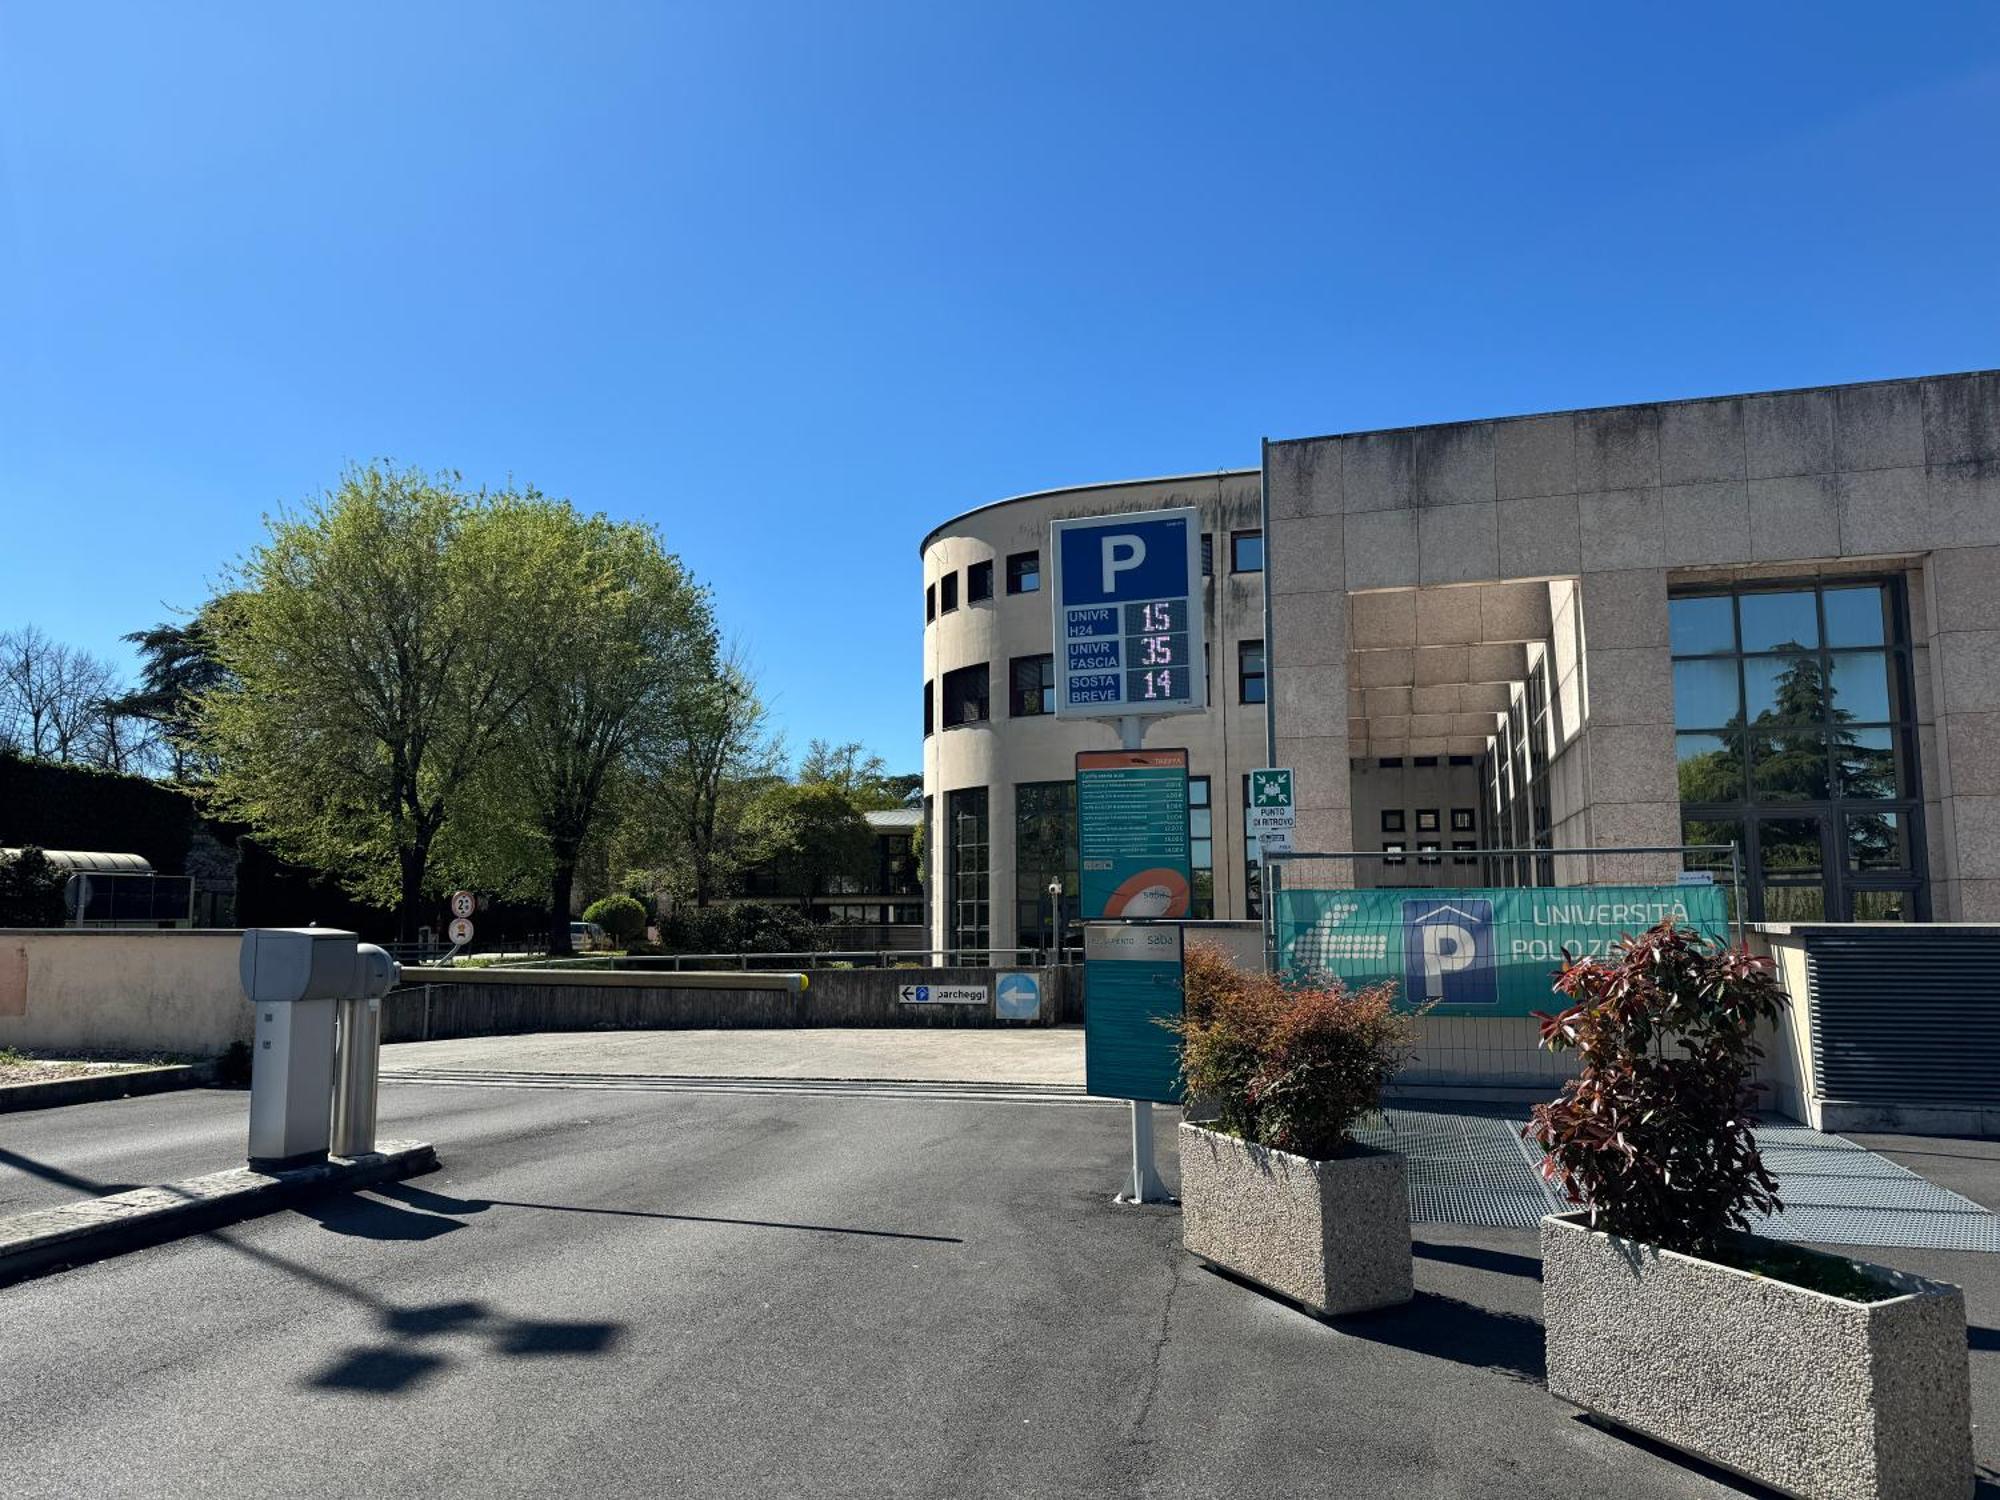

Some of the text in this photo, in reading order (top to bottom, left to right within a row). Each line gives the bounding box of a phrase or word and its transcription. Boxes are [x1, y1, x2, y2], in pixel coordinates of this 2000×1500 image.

[1101, 534, 1147, 594] P
[1069, 610, 1109, 622] UNIVR
[1142, 603, 1170, 631] 15
[1070, 625, 1093, 636] H24
[1070, 643, 1110, 655] UNIVR
[1141, 636, 1171, 665] 35
[1071, 657, 1118, 669] FASCIA
[1071, 676, 1115, 688] SOSTA
[1144, 670, 1171, 698] 14
[1071, 690, 1116, 702] BREVE
[1260, 807, 1285, 816] PUNTO
[1262, 818, 1294, 826] RITROVO
[1533, 899, 1689, 926] UNIVERSITÀ
[1511, 939, 1582, 961] POLO
[1421, 925, 1476, 997] P
